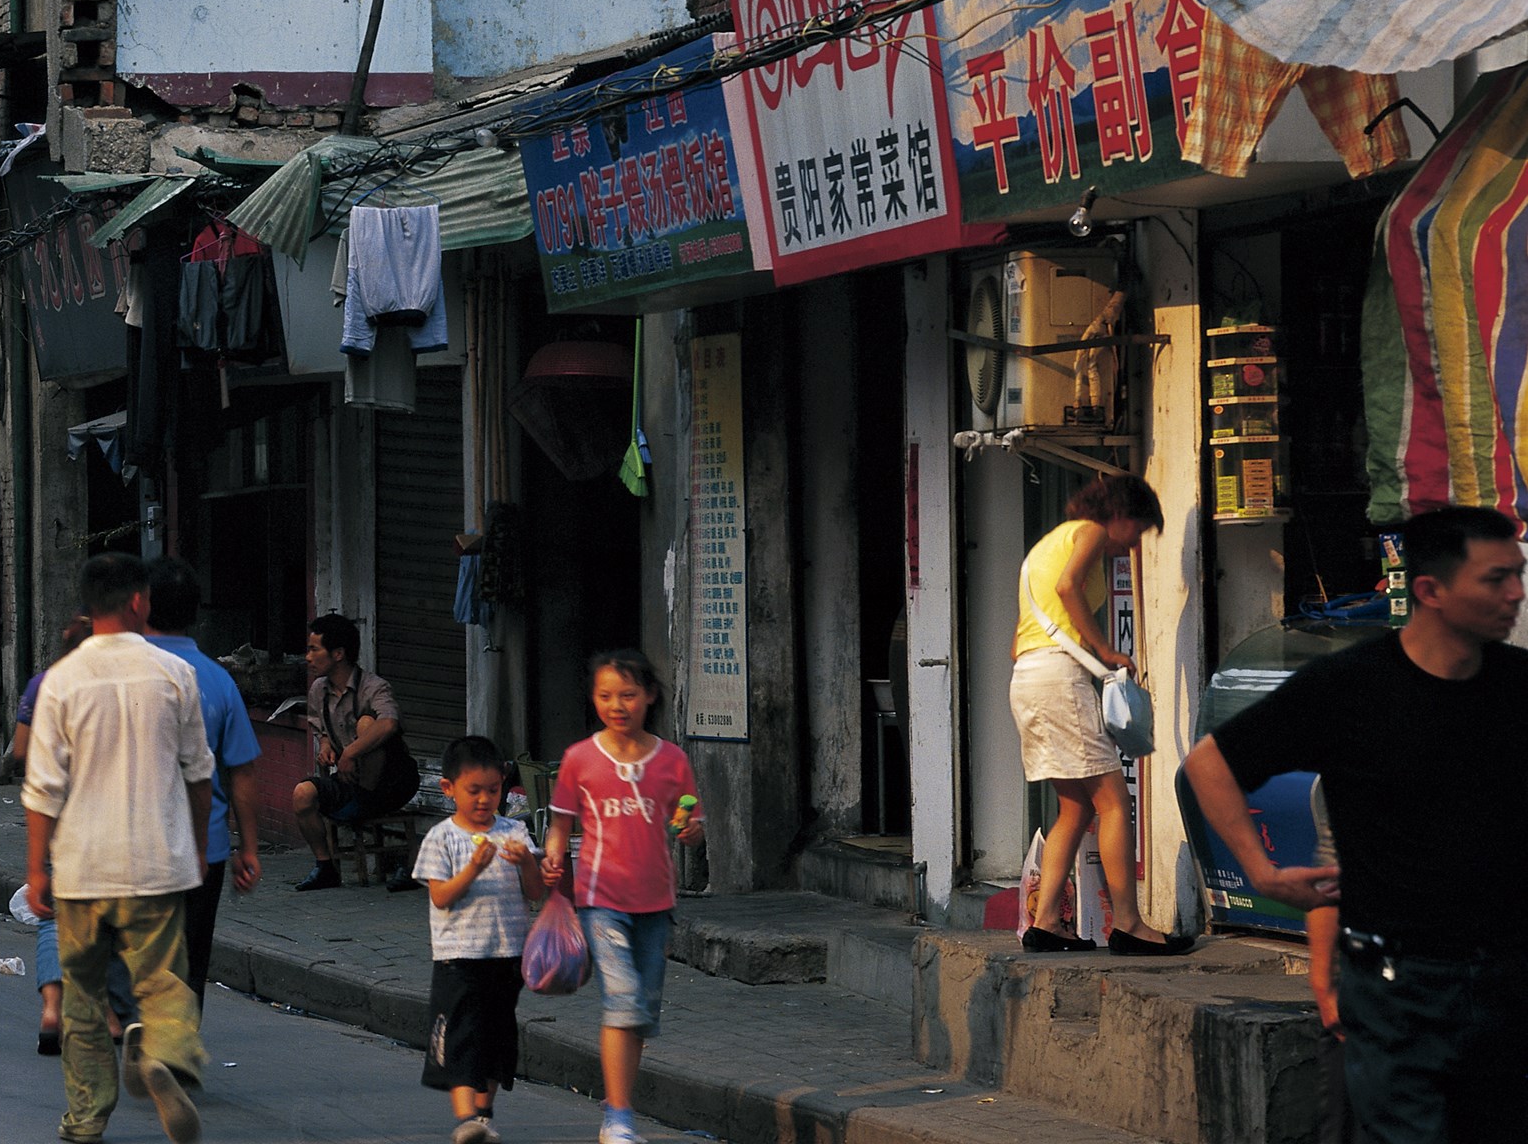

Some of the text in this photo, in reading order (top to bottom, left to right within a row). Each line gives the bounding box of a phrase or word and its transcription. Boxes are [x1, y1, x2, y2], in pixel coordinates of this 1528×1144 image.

[536, 182, 585, 255] 0791
[773, 119, 940, 248] 贵阳家常菜馆
